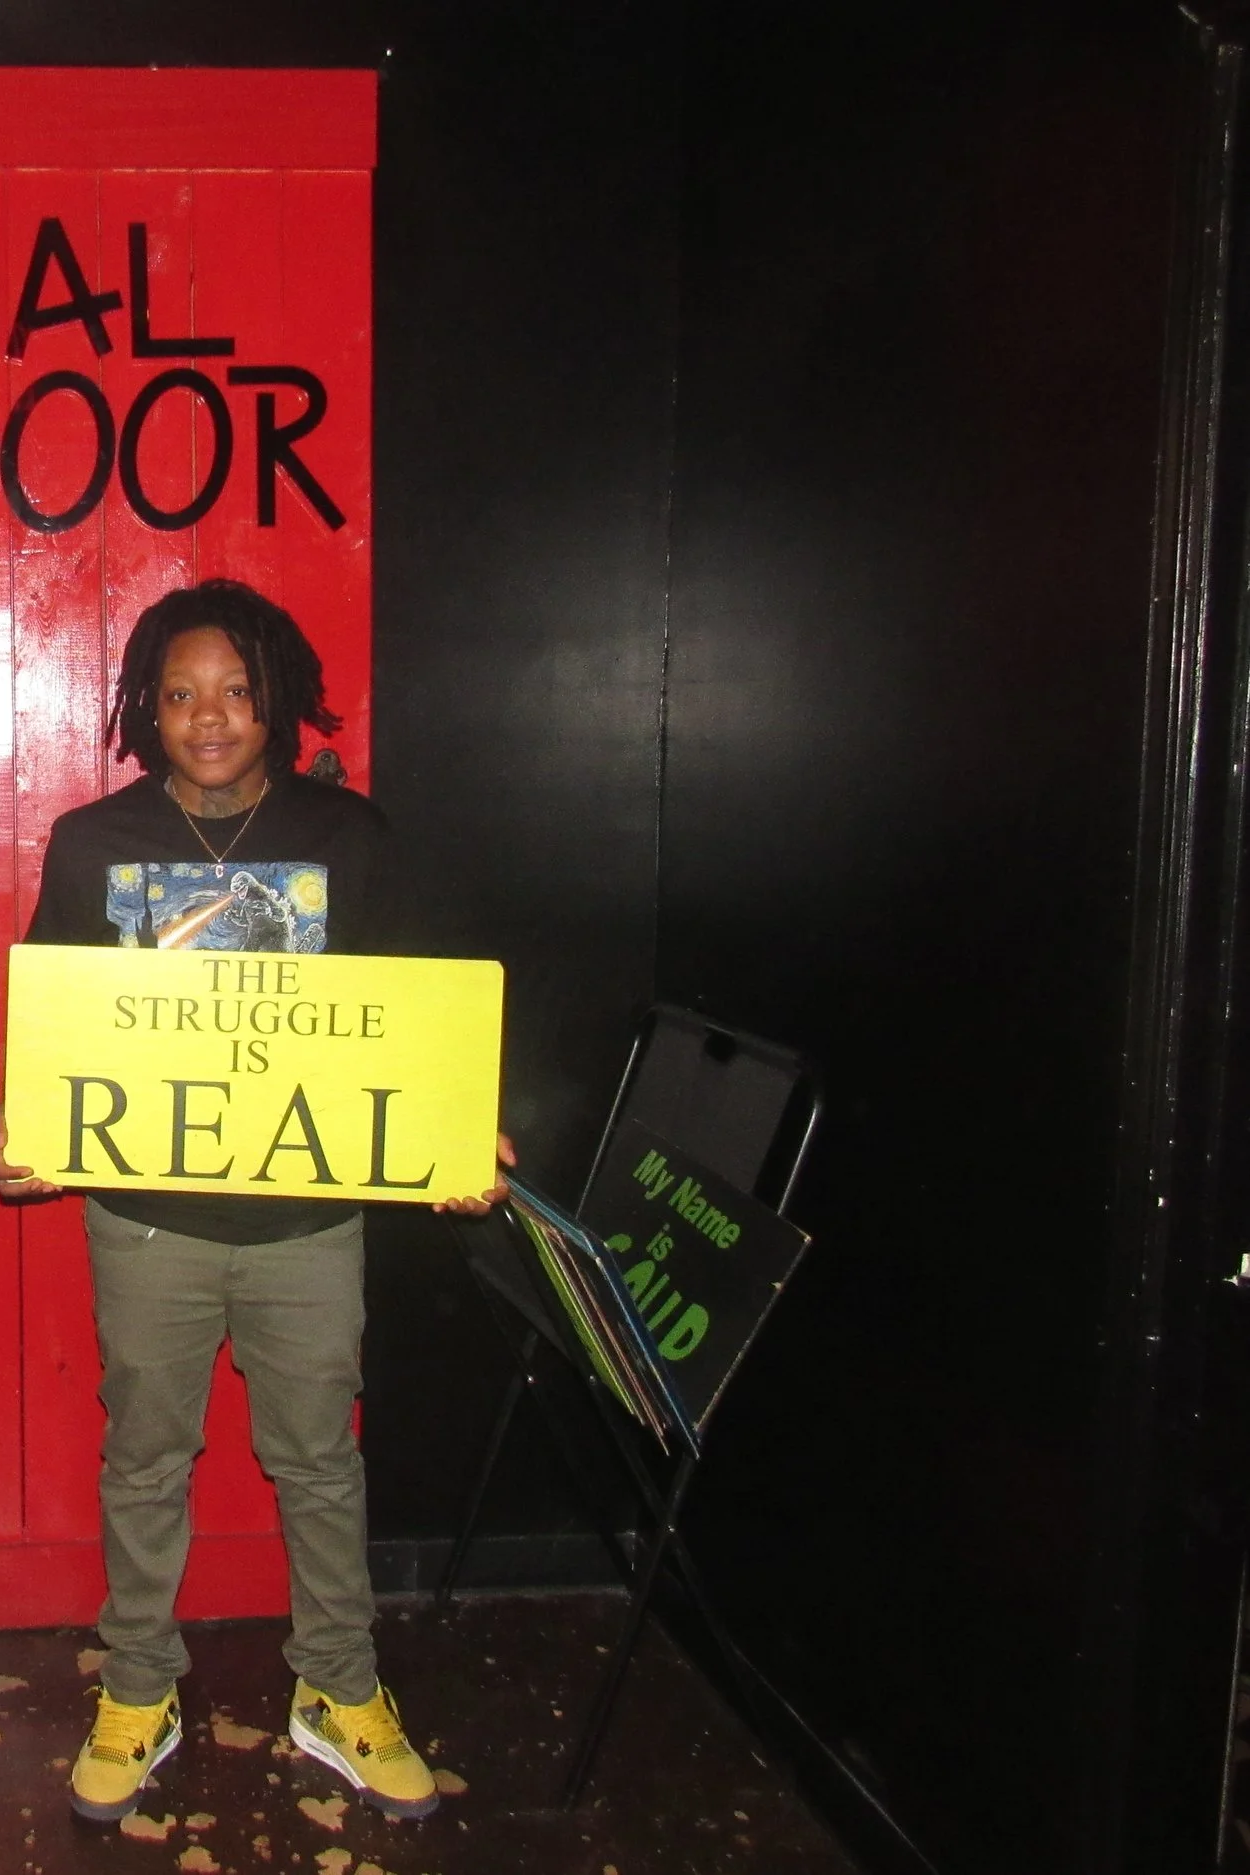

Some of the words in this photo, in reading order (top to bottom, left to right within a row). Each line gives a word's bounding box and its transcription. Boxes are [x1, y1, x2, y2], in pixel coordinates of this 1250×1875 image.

[202, 958, 300, 996] THE
[114, 995, 386, 1039] STRUGGLE
[229, 1039, 270, 1075] IS
[56, 1074, 437, 1190] REAL
[632, 1148, 675, 1201] My
[668, 1175, 742, 1250] Name
[645, 1222, 675, 1262] is
